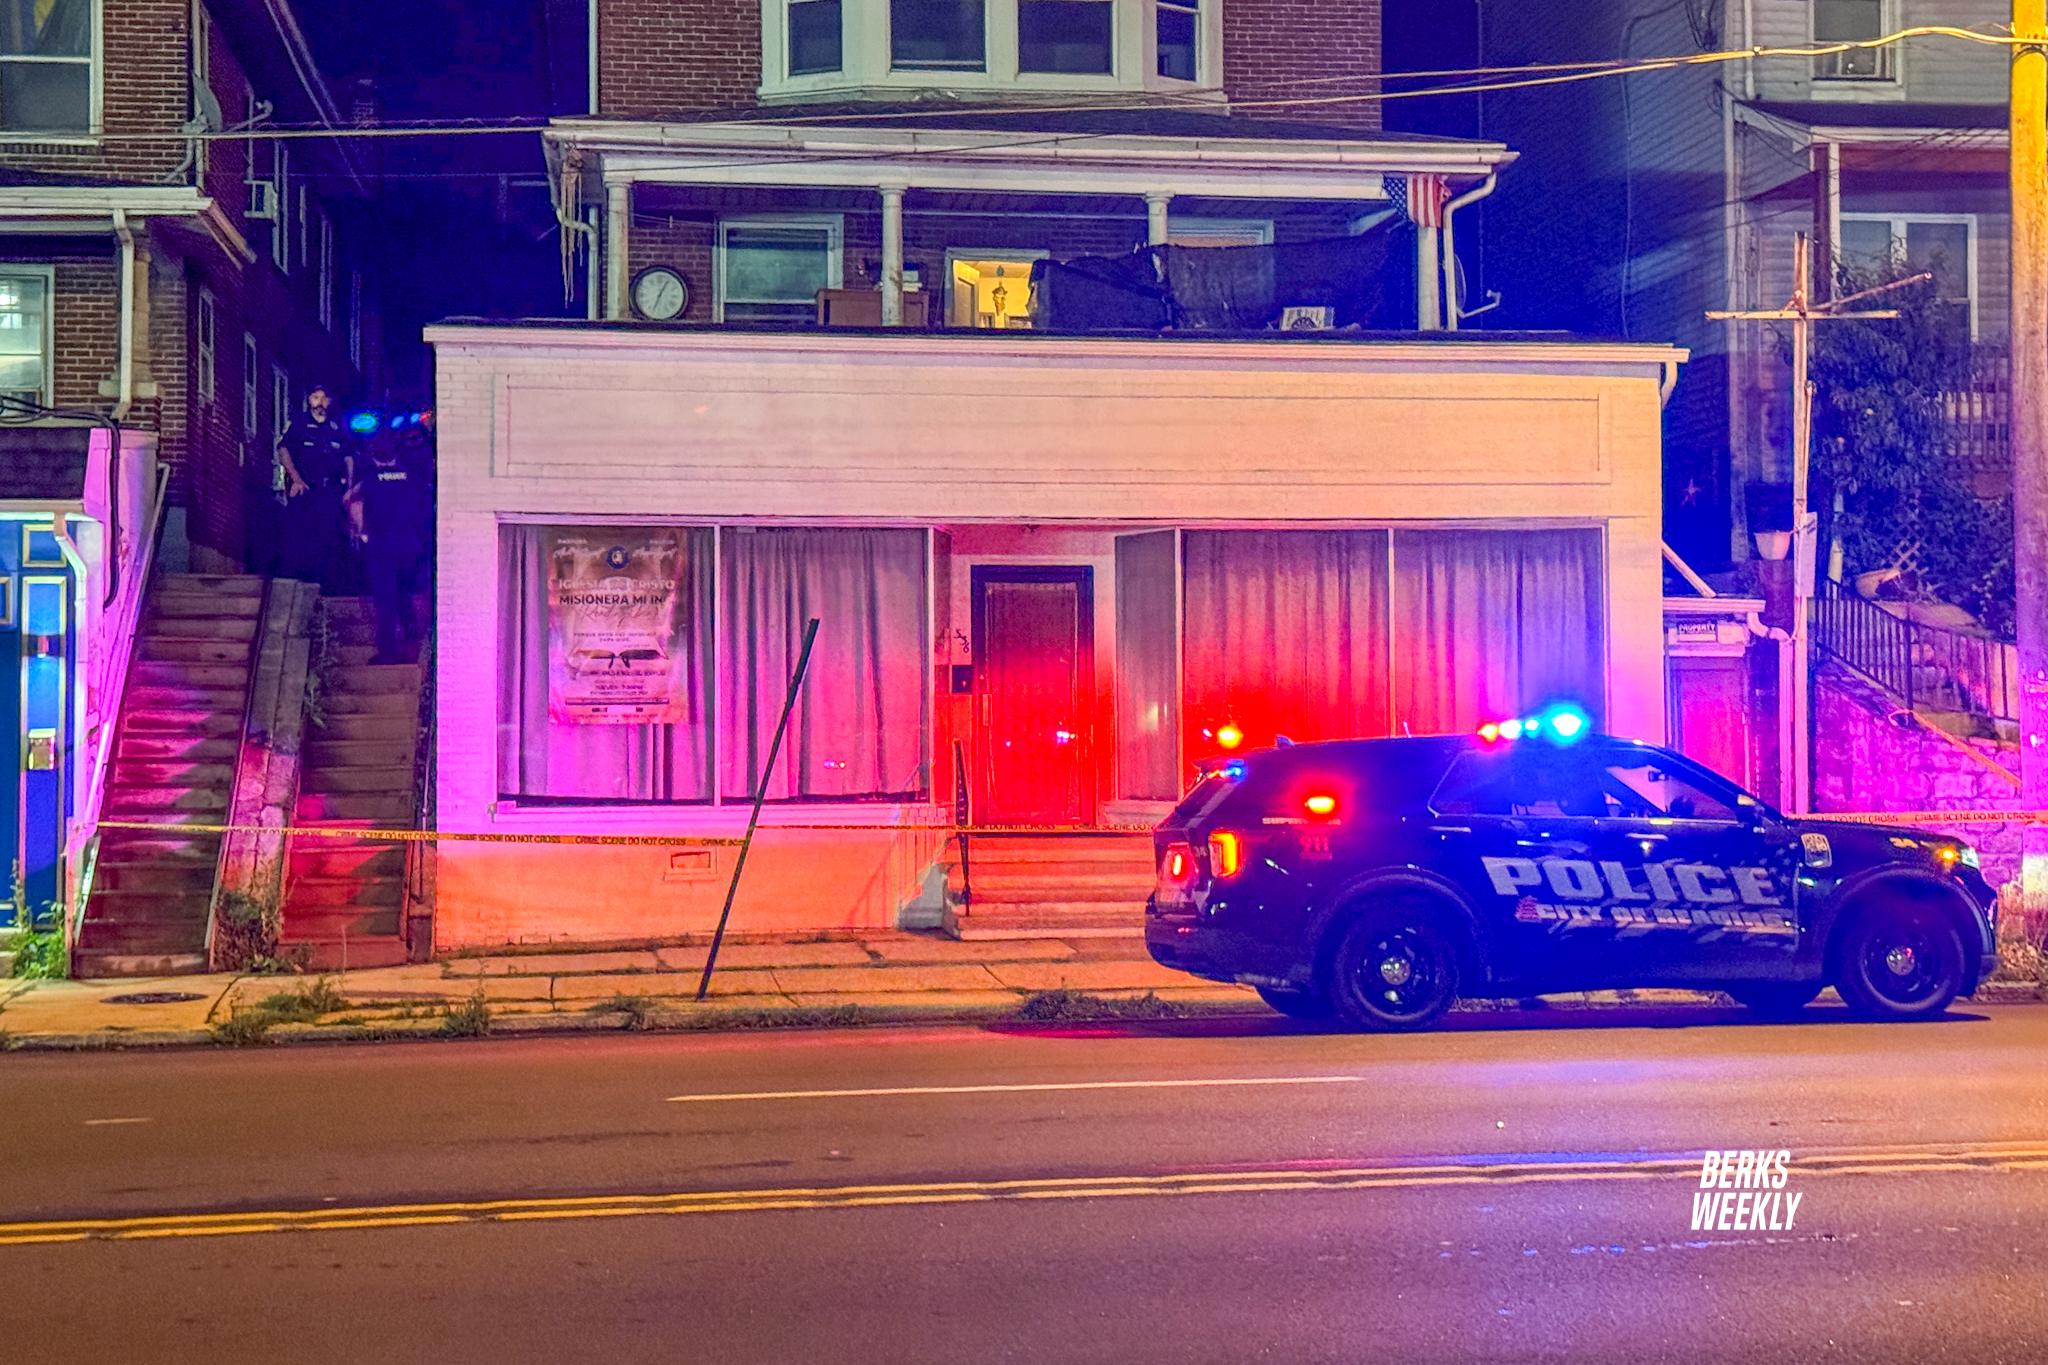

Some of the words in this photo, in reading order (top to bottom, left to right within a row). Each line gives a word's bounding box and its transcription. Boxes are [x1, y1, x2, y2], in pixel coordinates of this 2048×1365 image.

[559, 593, 629, 605] MISIONERA
[633, 594, 647, 605] MI
[1868, 815, 1898, 824] CROSS
[1988, 812, 2004, 820] NOT
[517, 835, 533, 843] NOT
[534, 835, 560, 843] CROSS
[575, 836, 600, 844] CRIME
[601, 836, 626, 845] SCENE
[627, 837, 640, 845] DO
[640, 837, 656, 845] NOT
[658, 837, 686, 846] CROSS
[701, 838, 726, 846] CRIME
[1481, 856, 1782, 906] POLICE
[1536, 904, 1602, 921] CITY
